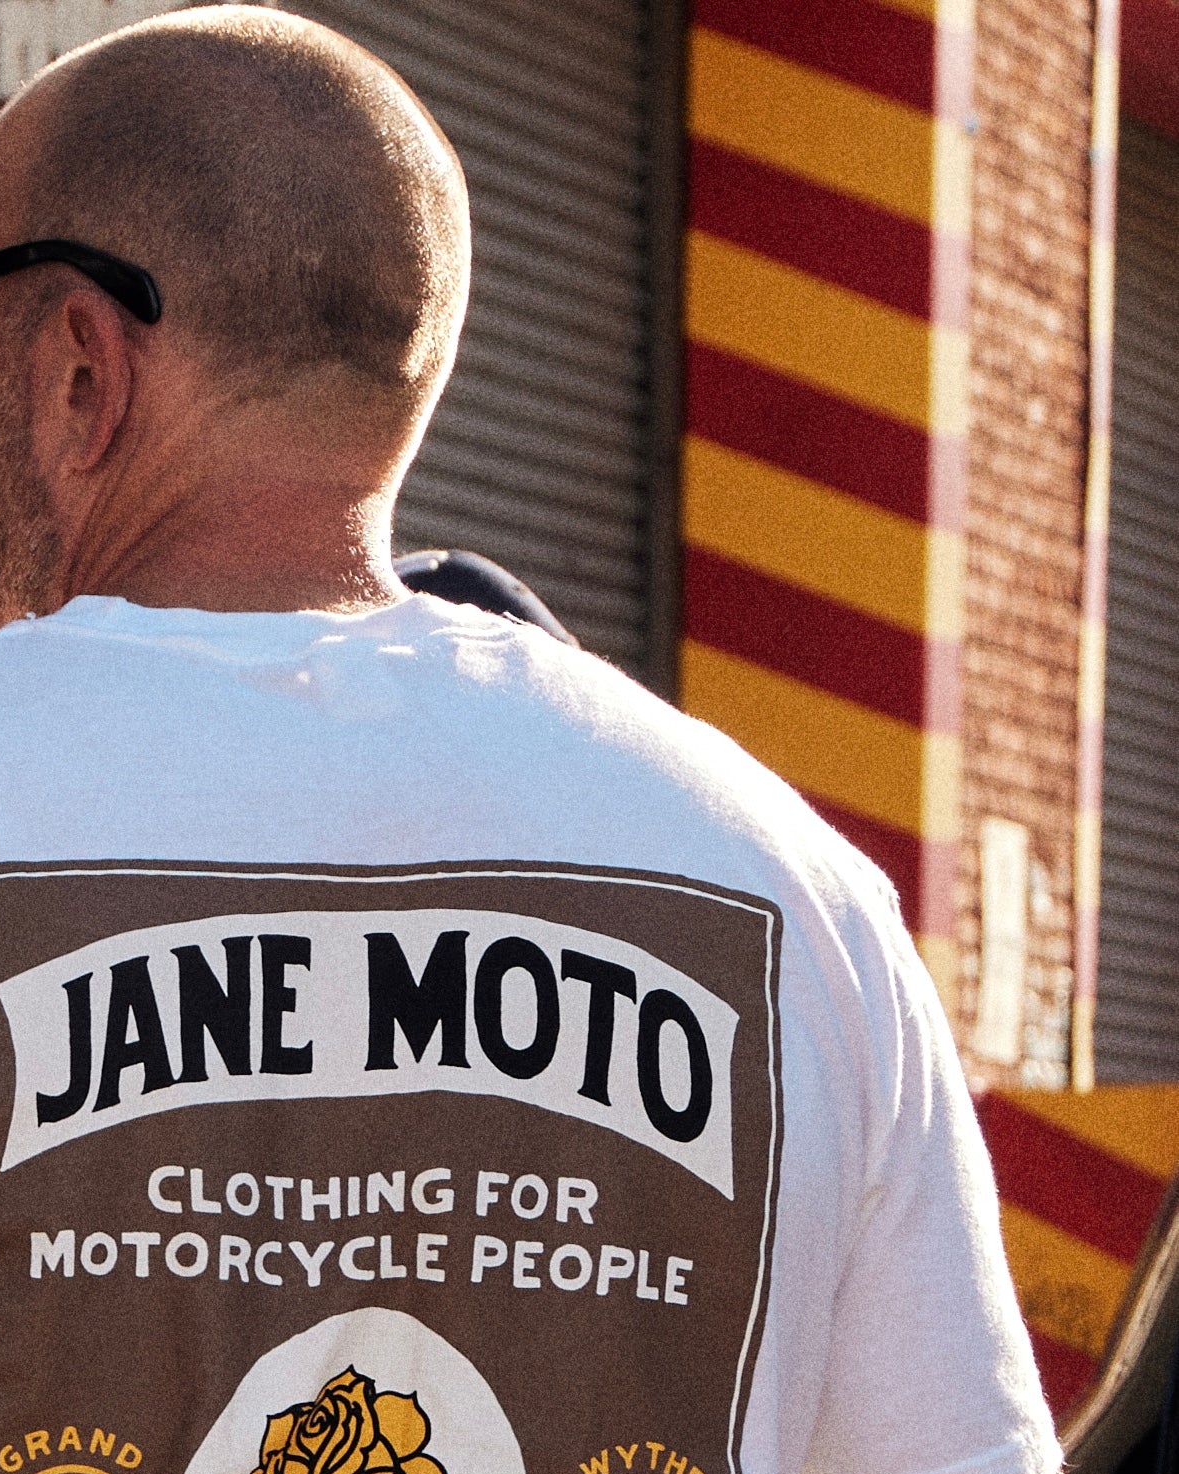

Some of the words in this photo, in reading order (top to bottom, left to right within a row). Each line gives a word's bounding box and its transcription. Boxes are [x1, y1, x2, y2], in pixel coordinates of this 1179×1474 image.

[36, 934, 313, 1127] JANE
[364, 931, 712, 1143] MOTO
[148, 1166, 454, 1221] CLOTHING
[476, 1171, 598, 1224] FOR
[30, 1230, 448, 1287] MOTORCYCLE
[471, 1235, 693, 1305] PEOPLE
